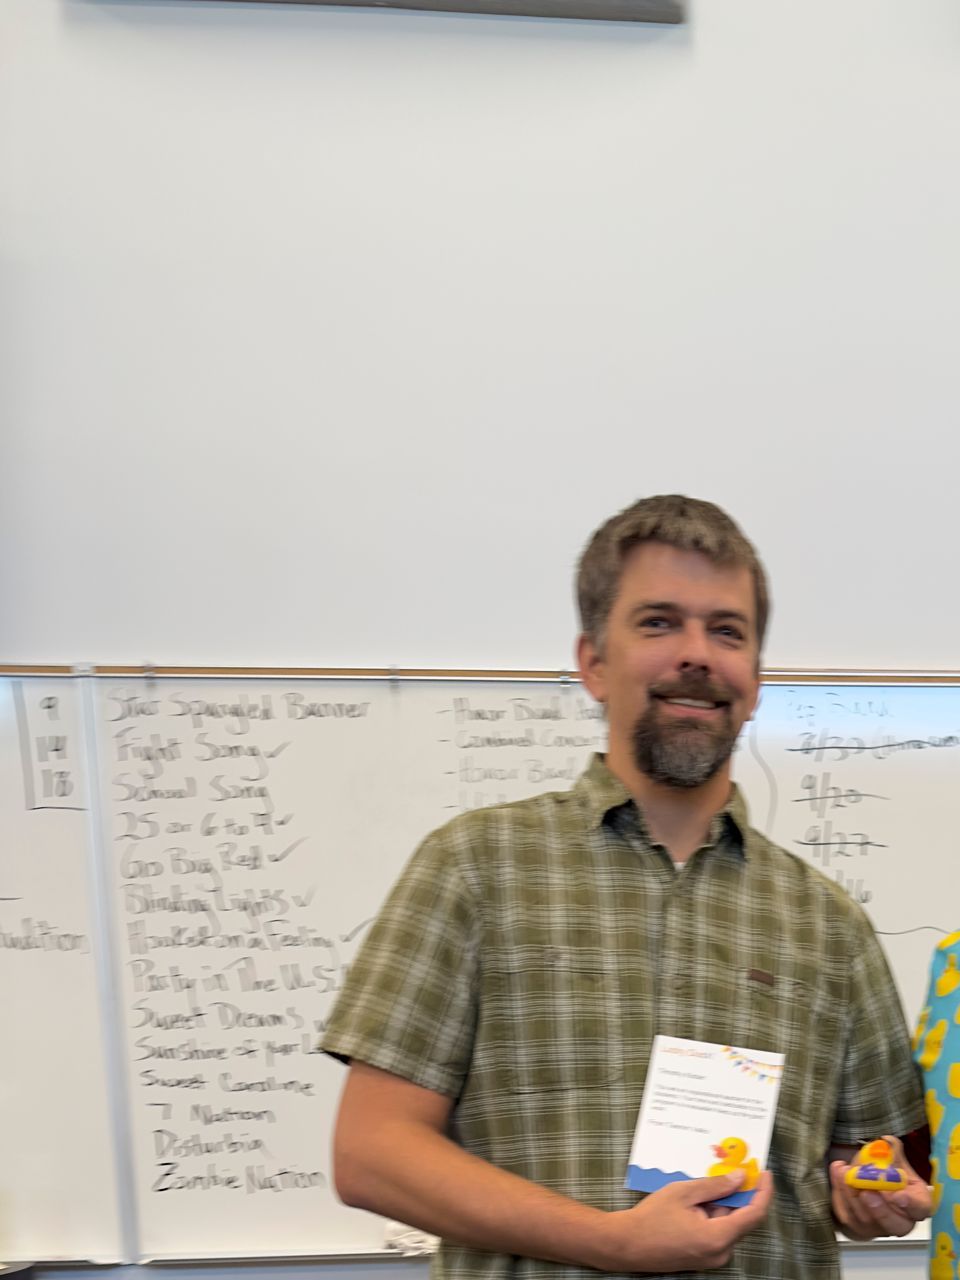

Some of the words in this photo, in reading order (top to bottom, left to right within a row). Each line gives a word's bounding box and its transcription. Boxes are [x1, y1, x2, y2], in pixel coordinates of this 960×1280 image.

[194, 732, 269, 781] Song
[209, 773, 276, 814] Song
[114, 811, 160, 841] 25
[200, 812, 218, 837] 6
